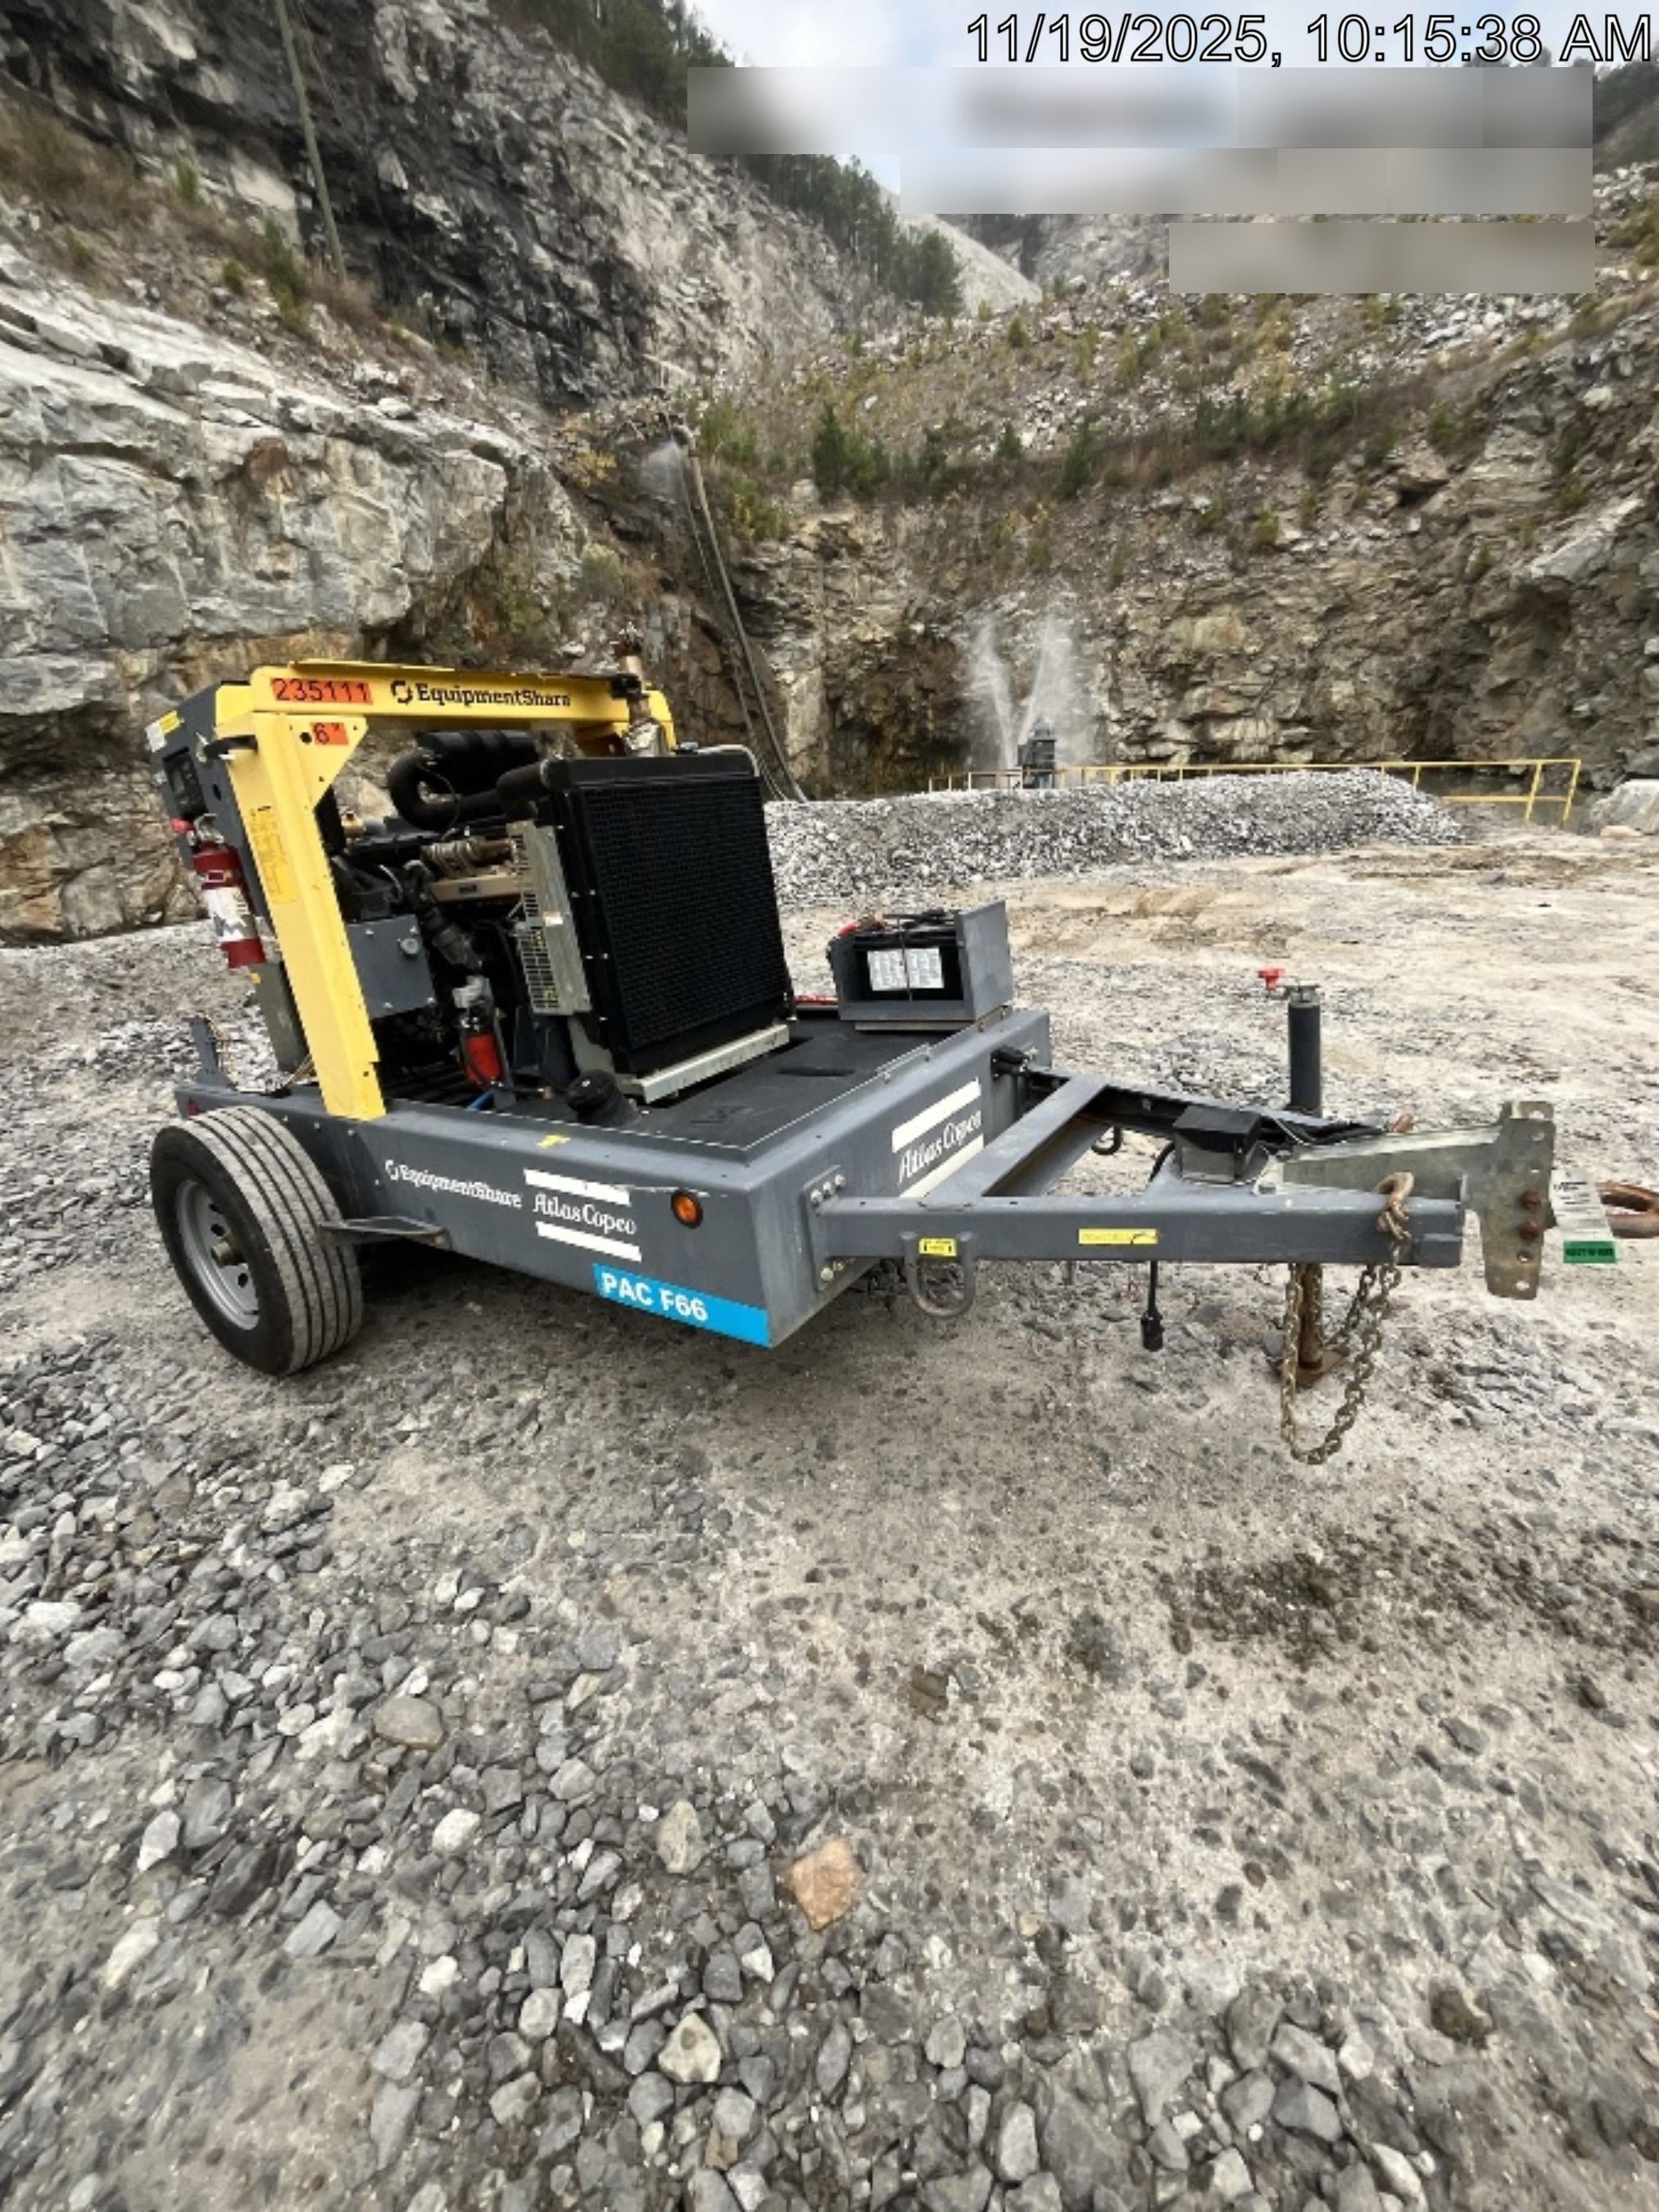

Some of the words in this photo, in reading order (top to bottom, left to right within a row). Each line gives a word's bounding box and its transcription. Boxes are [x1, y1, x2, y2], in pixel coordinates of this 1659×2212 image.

[272, 678, 367, 701] 235111
[533, 1192, 581, 1222] Atlas
[582, 1203, 637, 1235] Copco
[601, 1271, 653, 1306] PAC
[659, 1287, 708, 1321] F66
